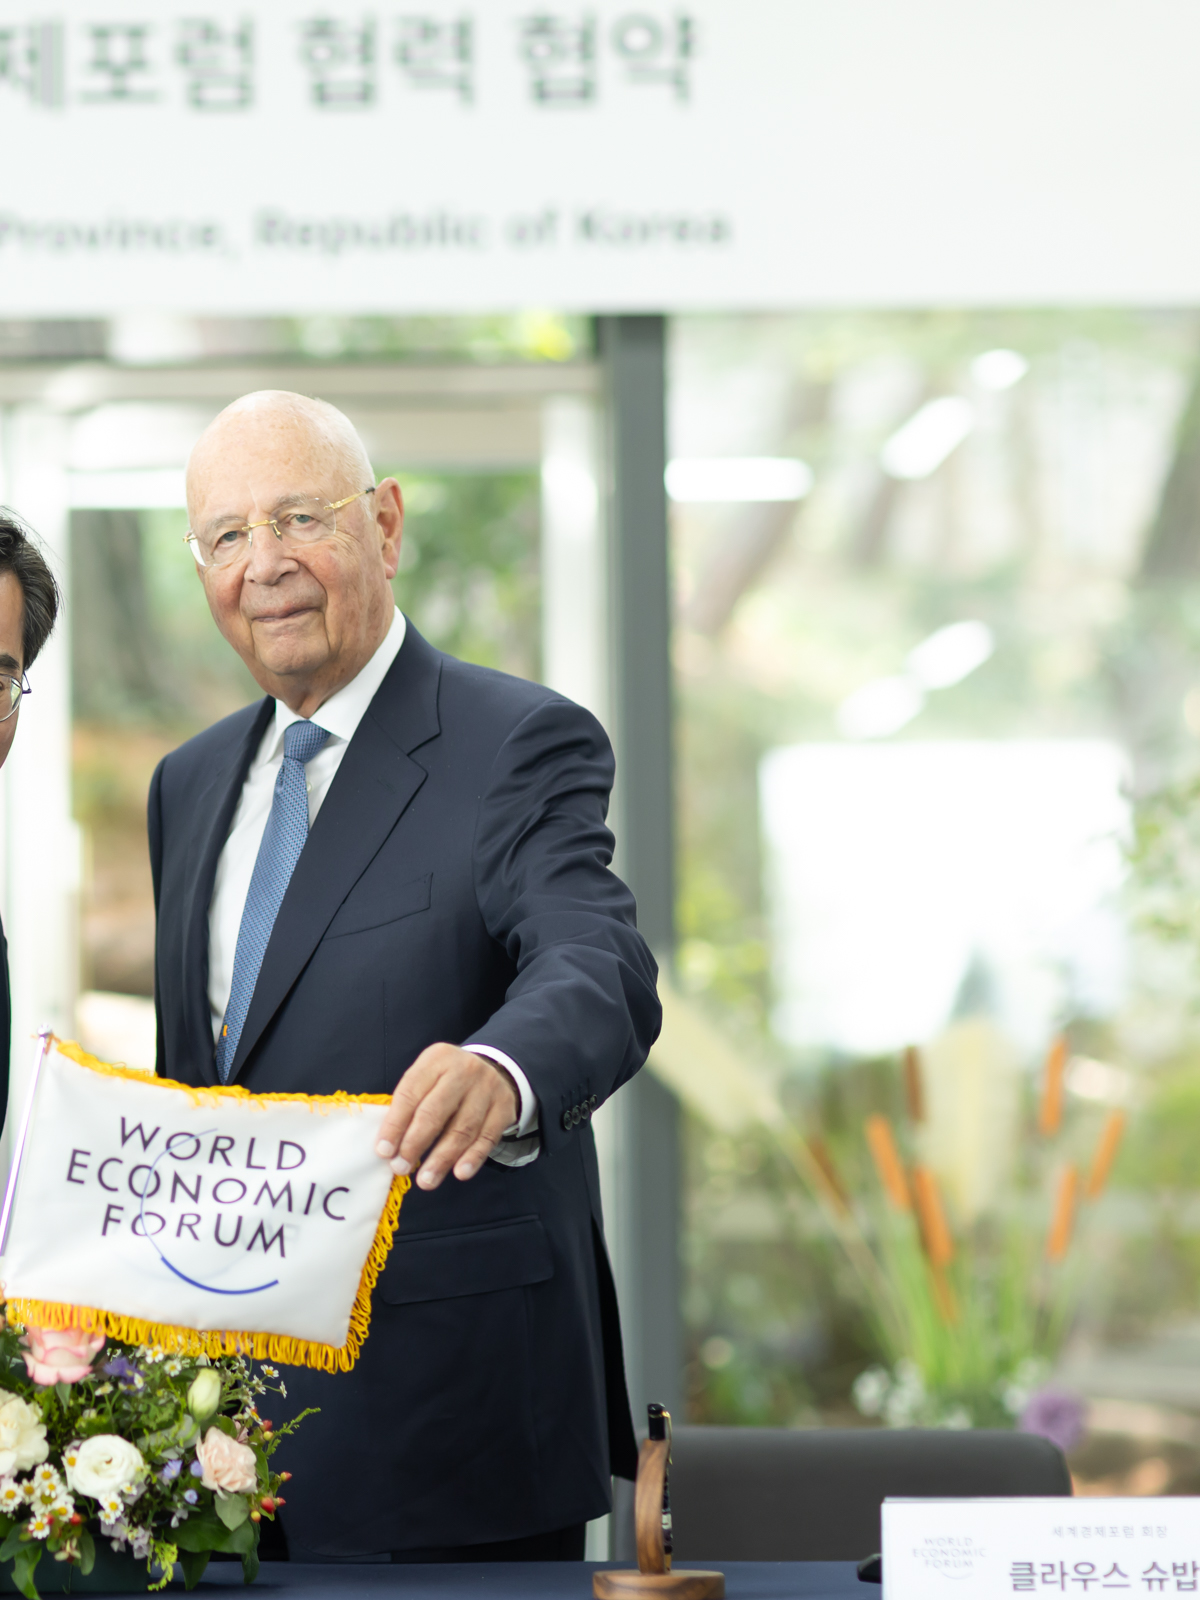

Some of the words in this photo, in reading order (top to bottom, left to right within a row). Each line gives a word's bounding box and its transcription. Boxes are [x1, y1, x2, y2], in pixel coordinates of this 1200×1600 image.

[298, 14, 476, 111] 협력
[518, 11, 697, 109] 협약
[252, 206, 486, 264] Republic
[504, 204, 562, 250] of
[573, 206, 733, 250] Korea
[119, 1115, 307, 1172] WORLD
[65, 1148, 351, 1221] ECONOMIC
[100, 1203, 287, 1259] FORUM
[912, 1547, 987, 1559] ECONOMIC
[924, 1536, 974, 1547] WORLD
[1052, 1525, 1135, 1539] 세계경제포럼
[1141, 1525, 1169, 1539] 회장
[924, 1558, 974, 1569] FORUM
[1009, 1560, 1131, 1592] 클라우스
[1141, 1560, 1200, 1592] 슈밥
